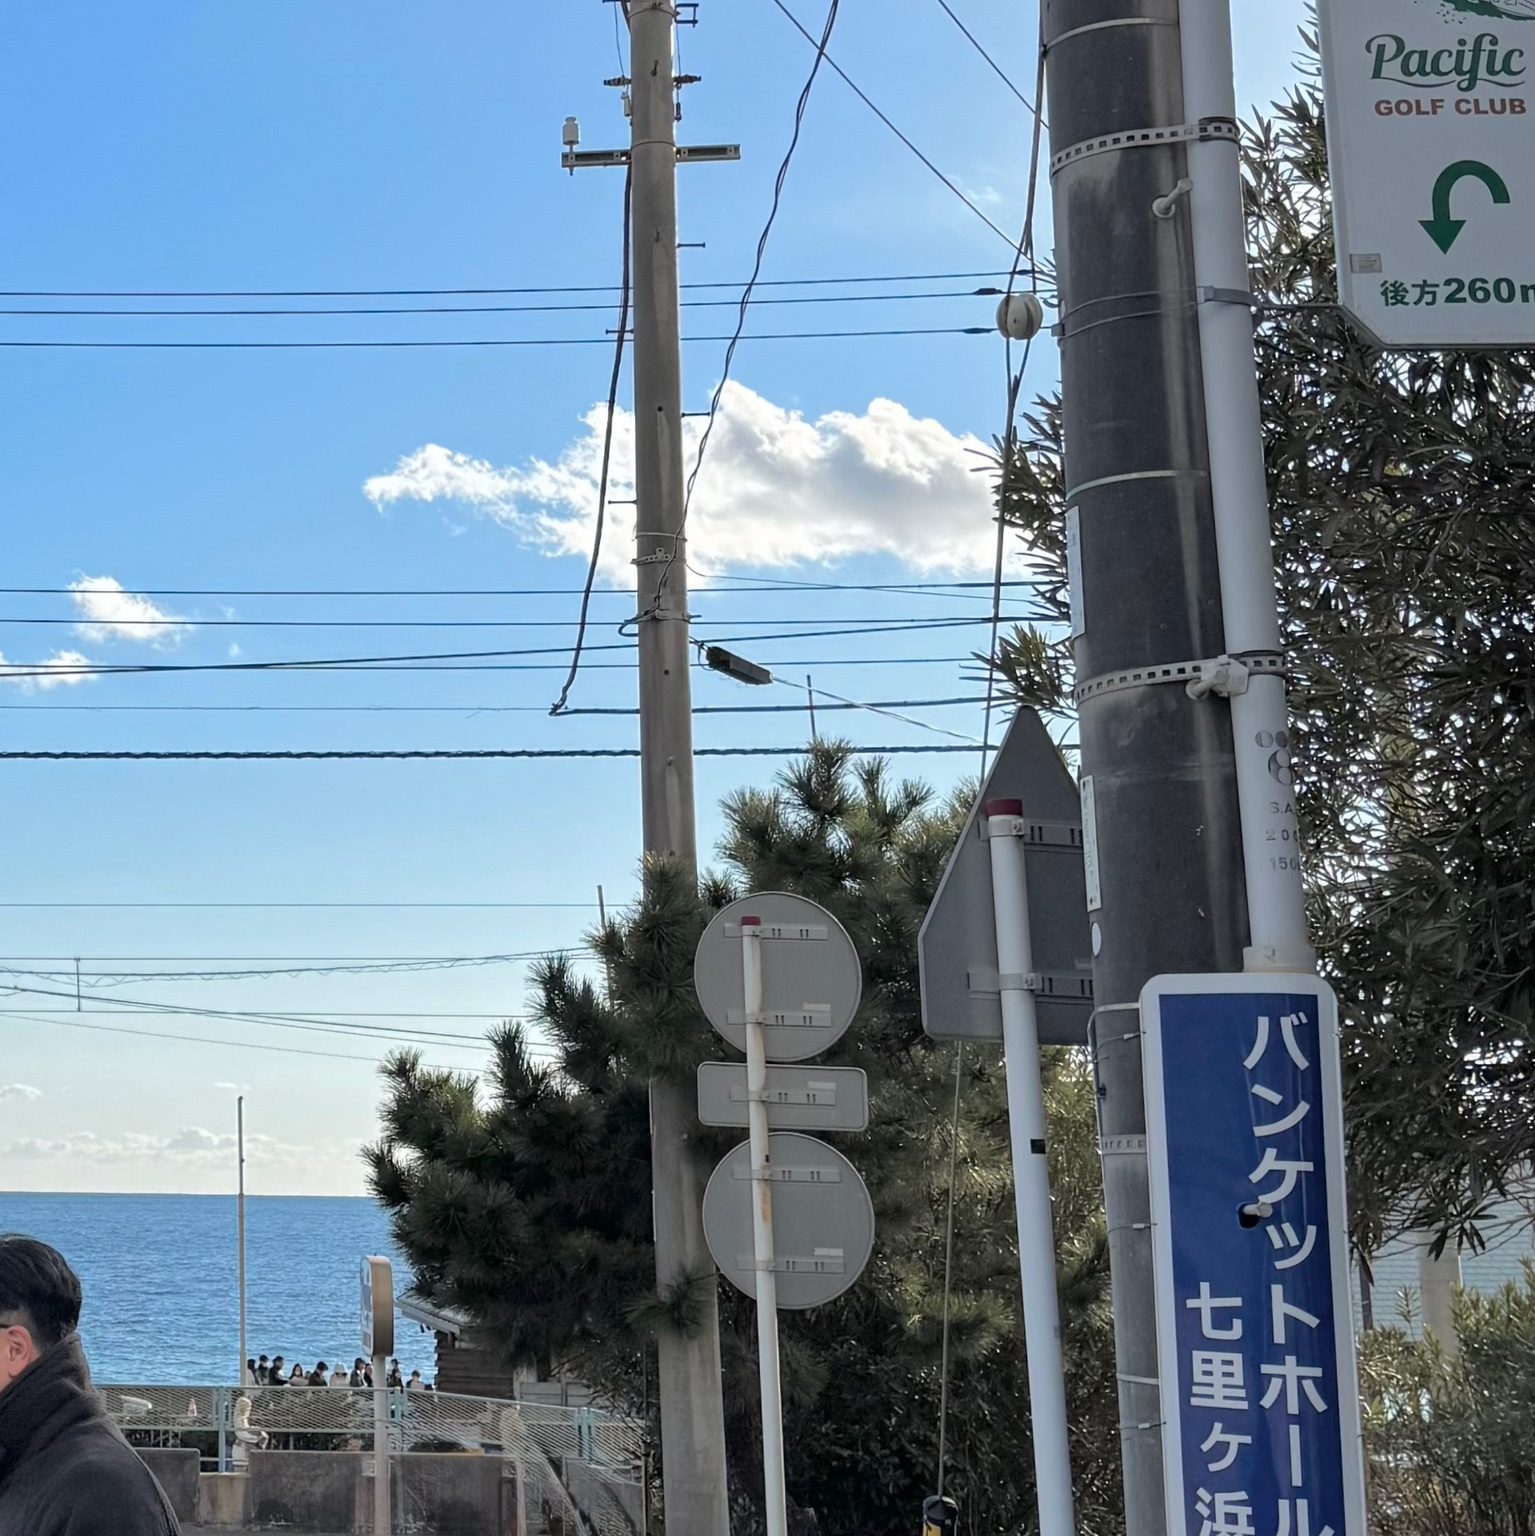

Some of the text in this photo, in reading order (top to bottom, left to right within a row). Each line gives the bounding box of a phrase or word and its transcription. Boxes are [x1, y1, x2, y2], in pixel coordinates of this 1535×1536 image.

[1365, 33, 1527, 92] Pacific
[1374, 98, 1527, 116] GOLF CLUB
[1270, 856, 1301, 871] 150
